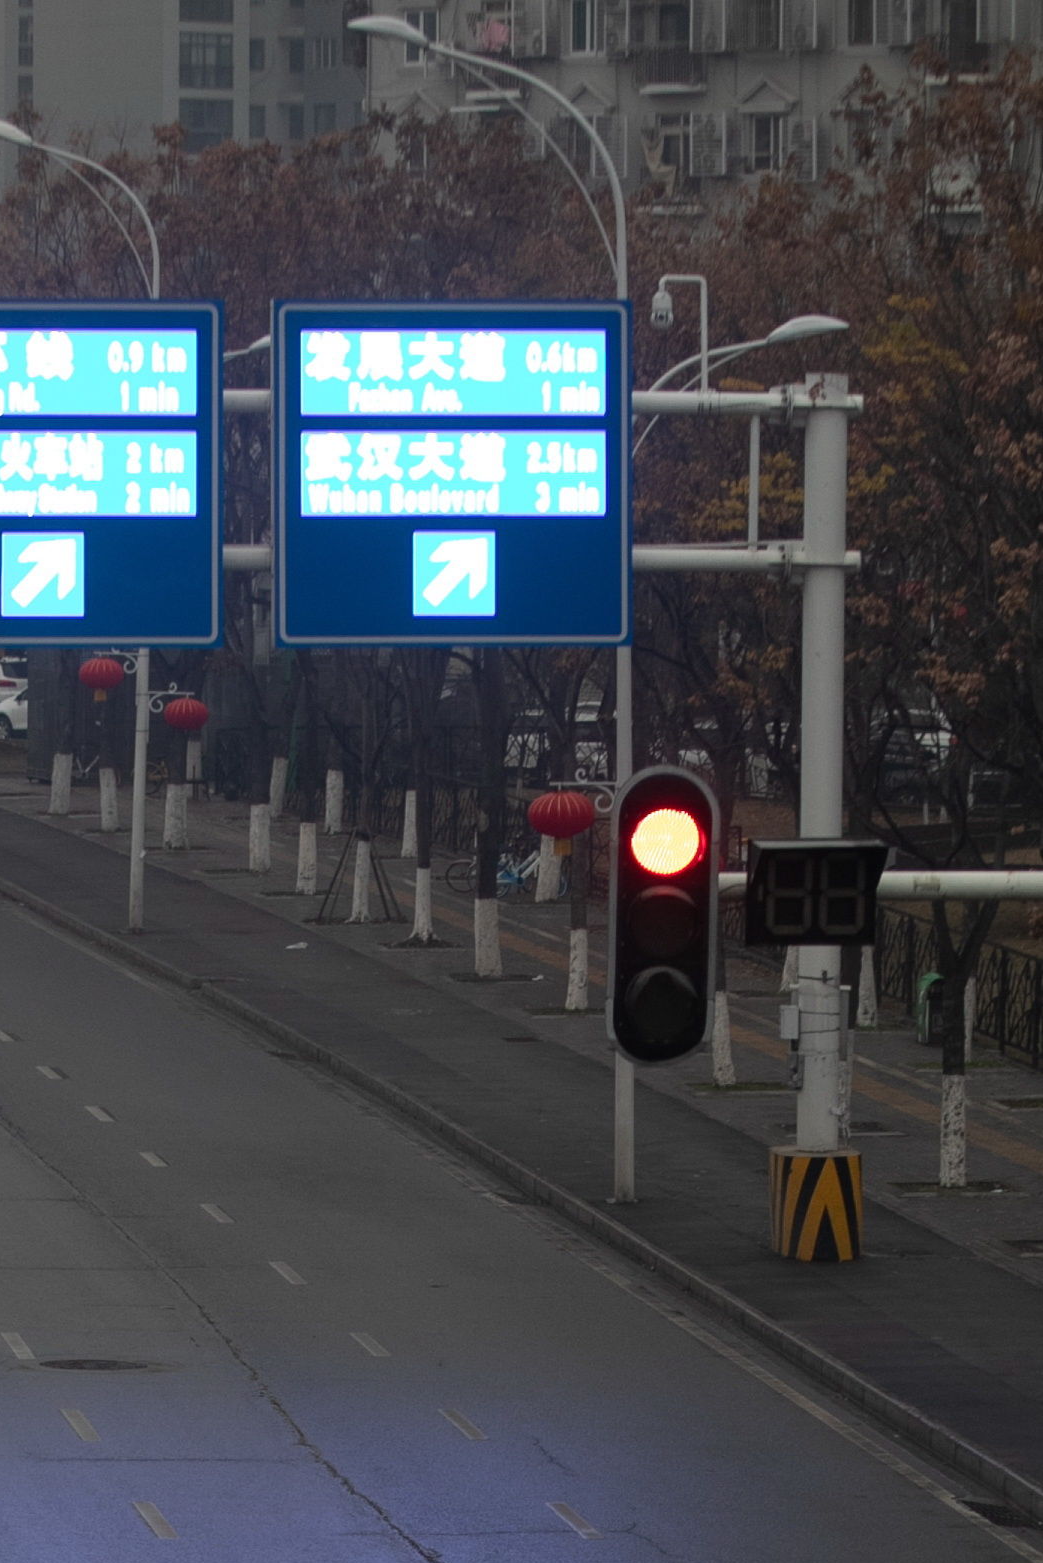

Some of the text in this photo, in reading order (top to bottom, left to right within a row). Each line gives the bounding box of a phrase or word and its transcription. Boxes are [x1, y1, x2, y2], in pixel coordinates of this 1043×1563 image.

[108, 341, 187, 372] 0.9 km
[305, 331, 505, 381] 发展大道
[120, 381, 179, 412] 1 min
[542, 381, 600, 412] 1 min
[150, 443, 184, 473] km
[305, 432, 506, 482] 武汉大道
[150, 481, 190, 513] min
[309, 483, 499, 513] Wuhan Boulevard
[559, 481, 599, 513] min
